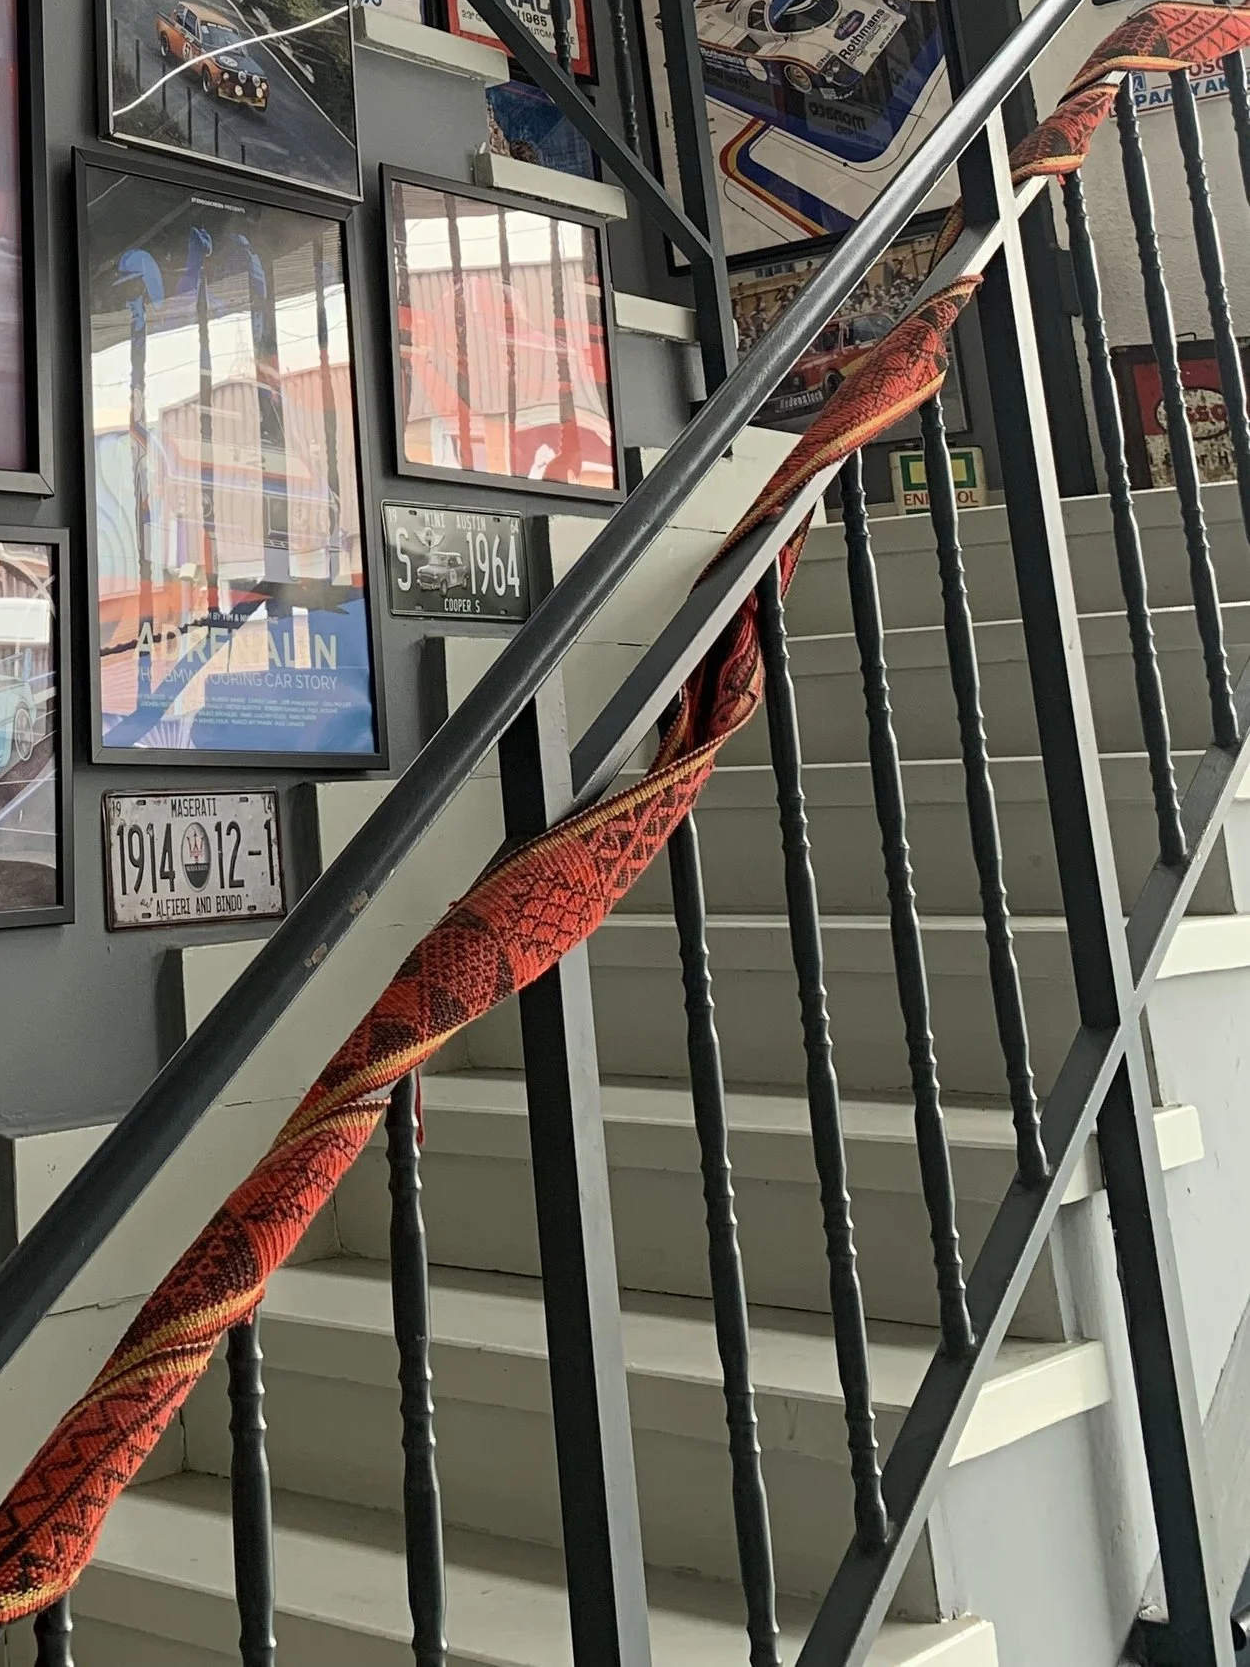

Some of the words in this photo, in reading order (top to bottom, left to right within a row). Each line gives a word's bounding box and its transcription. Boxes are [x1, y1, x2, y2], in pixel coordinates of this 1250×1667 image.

[522, 11, 547, 27] 1965
[839, 8, 885, 60] Rothmans
[904, 492, 979, 506] ENOL
[389, 509, 398, 522] 19
[425, 513, 445, 528] MINI
[456, 515, 486, 531] AUSTIN
[510, 521, 519, 533] 64
[396, 527, 412, 591] S
[466, 532, 520, 597] 1964
[444, 598, 471, 612] COOPER
[475, 599, 480, 613] S
[265, 673, 292, 687] CAR
[297, 676, 337, 690] STORY
[112, 801, 122, 817] 19
[171, 798, 217, 817] MASERATI
[116, 823, 176, 895] 1914
[156, 898, 190, 917] ALFIERI
[196, 897, 212, 914] AND
[216, 895, 242, 913] BINDO
